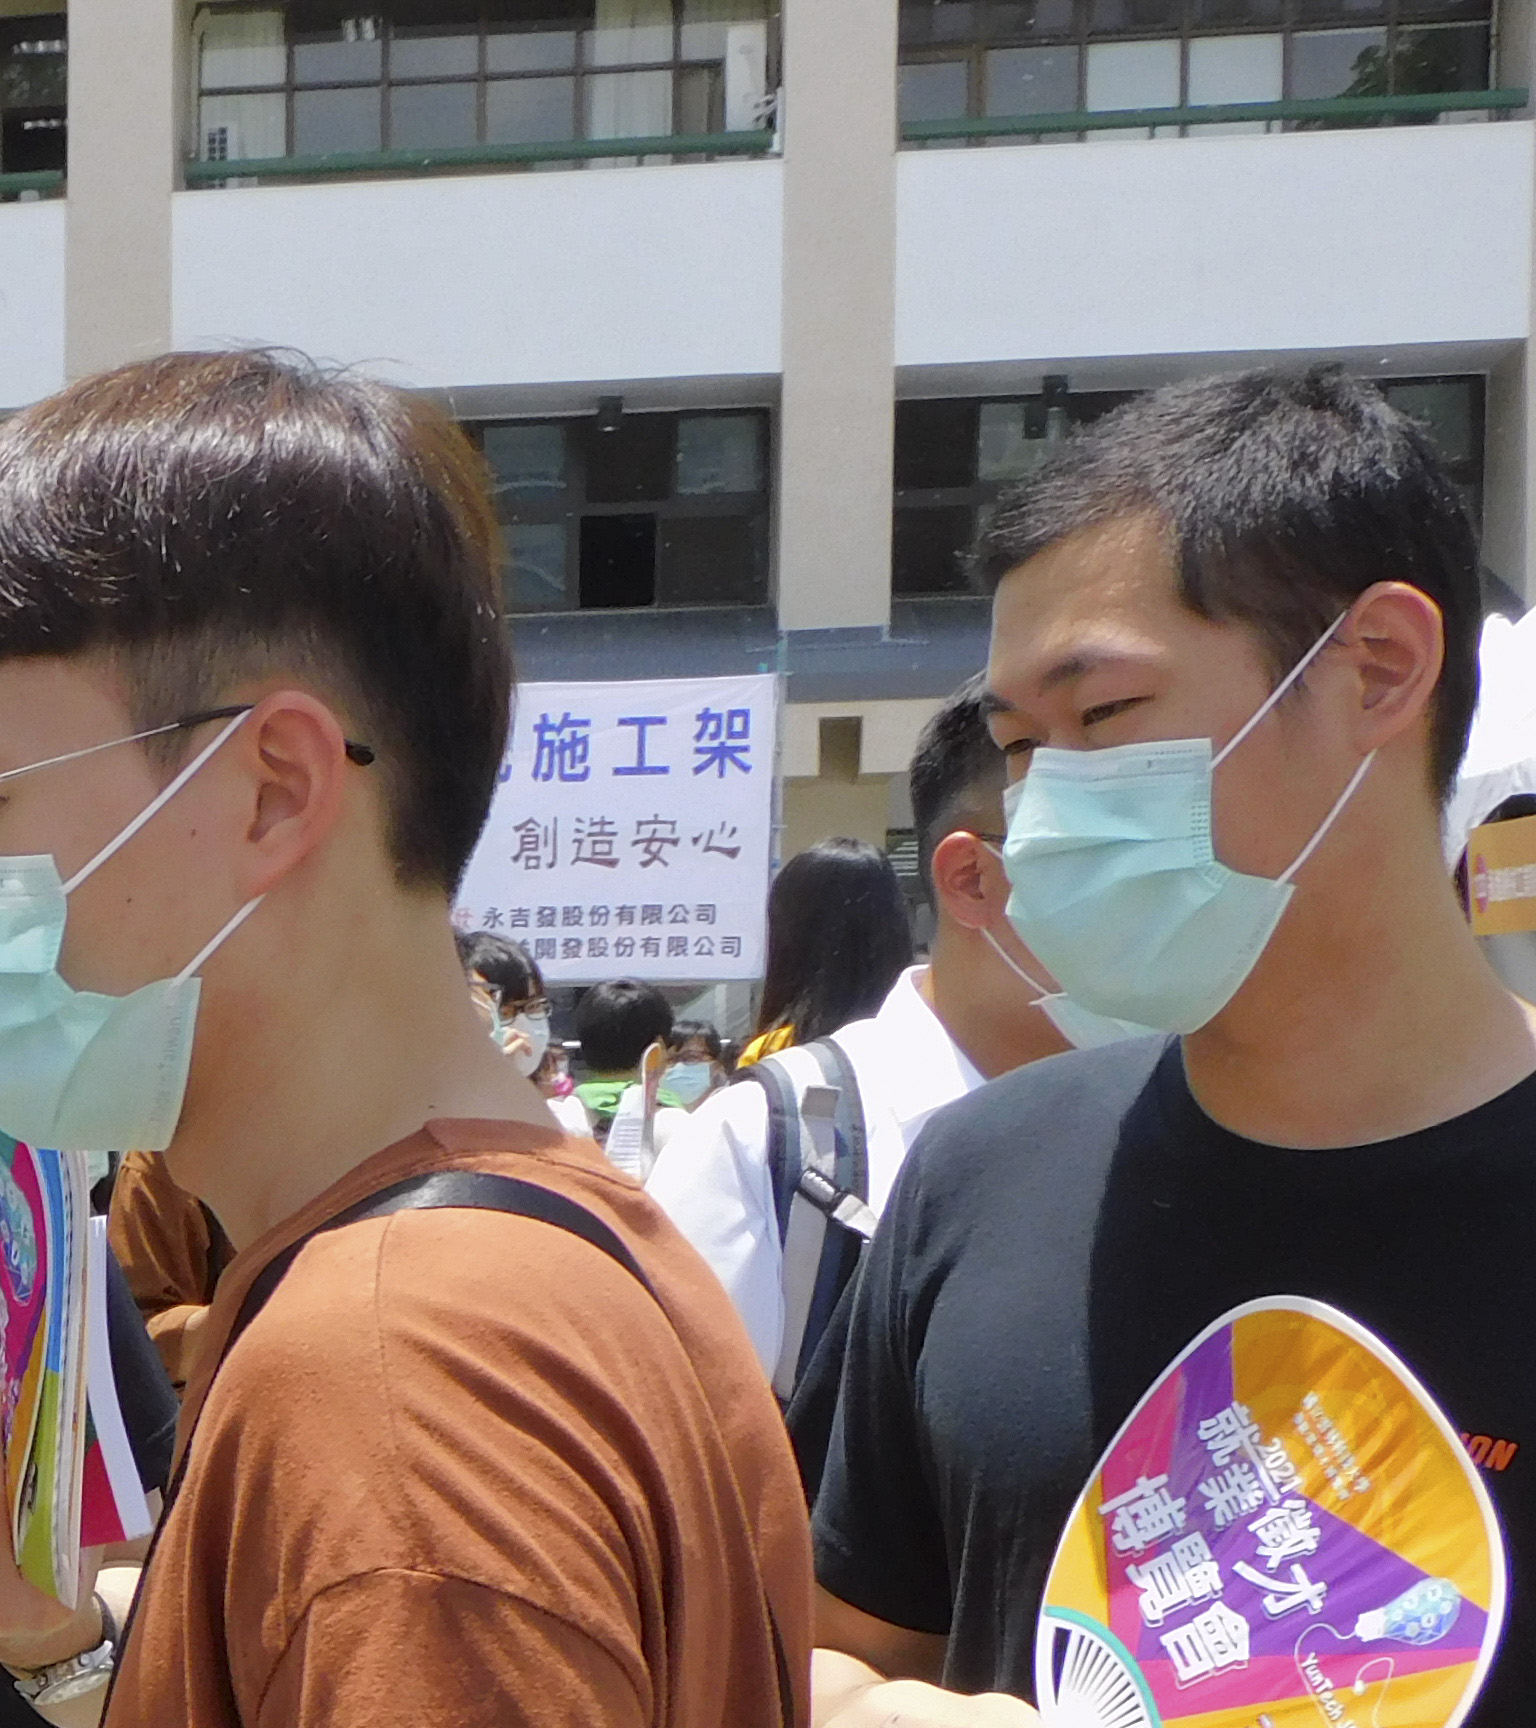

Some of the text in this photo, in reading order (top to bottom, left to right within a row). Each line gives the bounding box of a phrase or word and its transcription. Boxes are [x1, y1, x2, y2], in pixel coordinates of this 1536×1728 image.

[498, 708, 753, 783] 施工架
[511, 813, 743, 872] 創造安心
[482, 903, 718, 930] 永吉發股份有限公司
[518, 936, 743, 960] 開發股份有限公司
[1260, 1437, 1303, 1494] 2021
[1098, 1475, 1251, 1688] 博覽會
